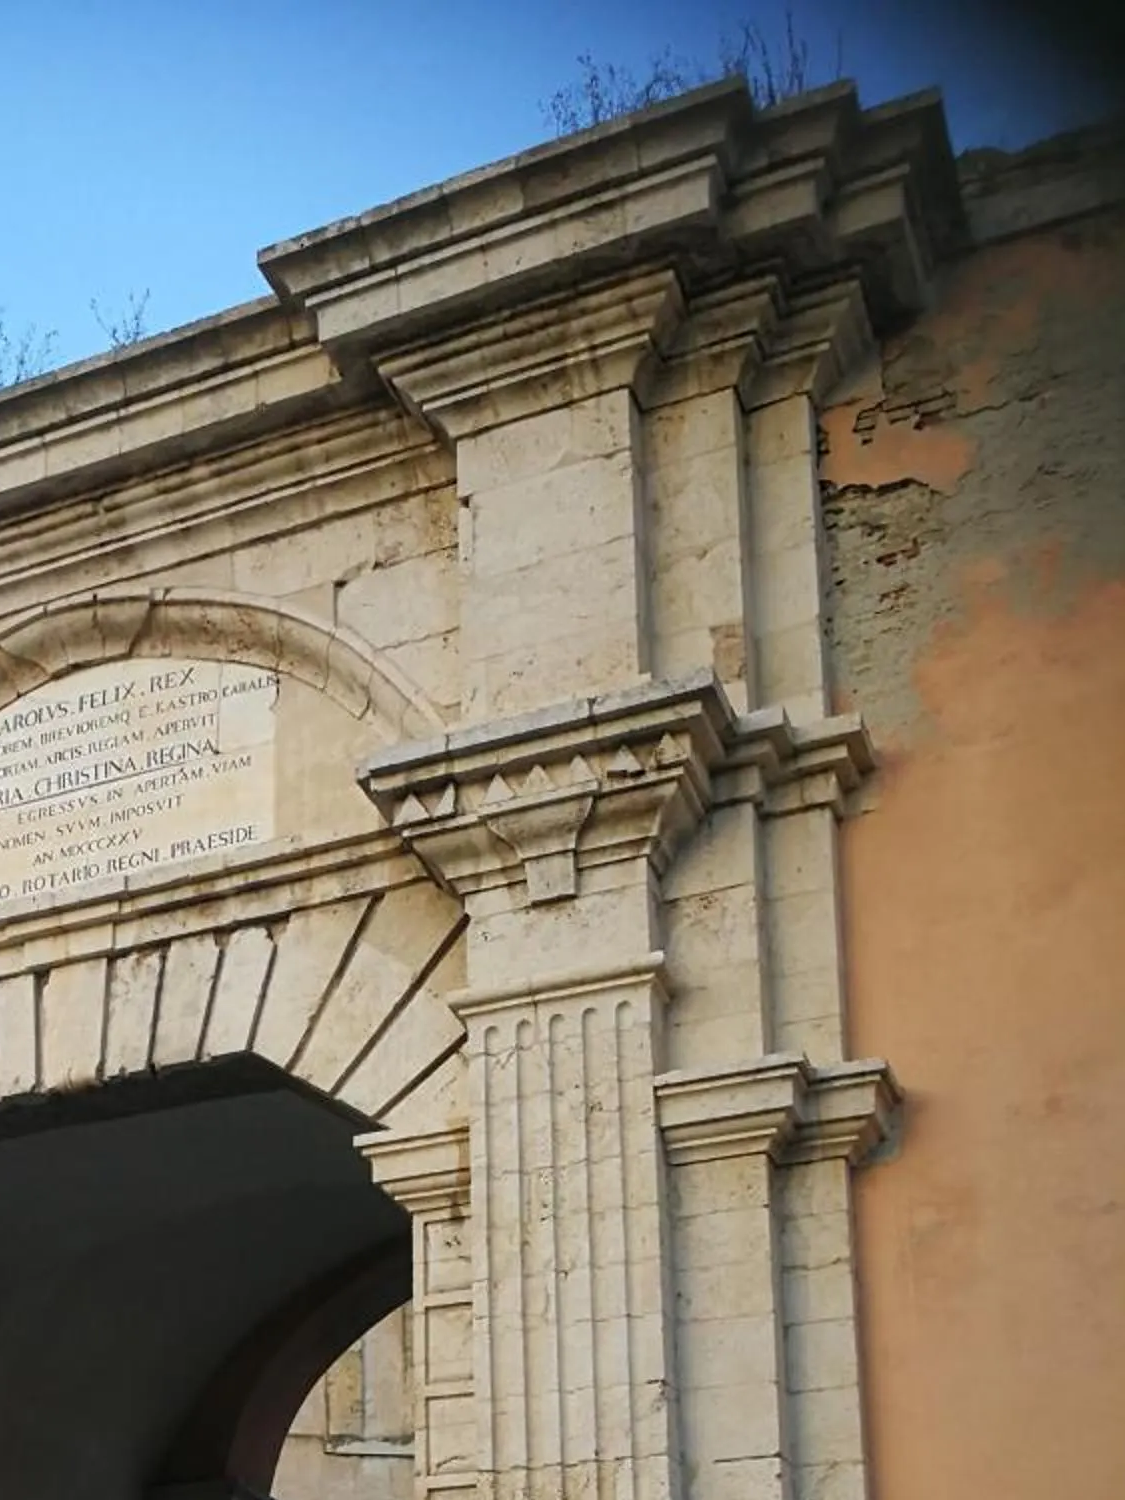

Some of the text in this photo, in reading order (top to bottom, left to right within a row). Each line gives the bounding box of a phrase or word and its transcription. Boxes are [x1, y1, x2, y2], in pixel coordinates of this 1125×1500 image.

[78, 681, 136, 713] FELIX
[150, 668, 195, 692] REX
[45, 746, 83, 764] ARCIS
[88, 730, 143, 755] REGIAM
[154, 713, 215, 738] APERVIT
[17, 796, 98, 825] EGRESSVS
[107, 788, 123, 802] IN
[135, 767, 203, 794] APERTAM
[212, 755, 251, 773] VIAM
[34, 756, 136, 797] CHRISTINA
[146, 739, 217, 768] REGINA
[56, 816, 100, 836] SVVM
[110, 795, 184, 824] IMPOSVIT
[22, 863, 99, 894] ROTARIO
[107, 848, 159, 874] REGNI
[170, 825, 258, 858] PRAESIDE
